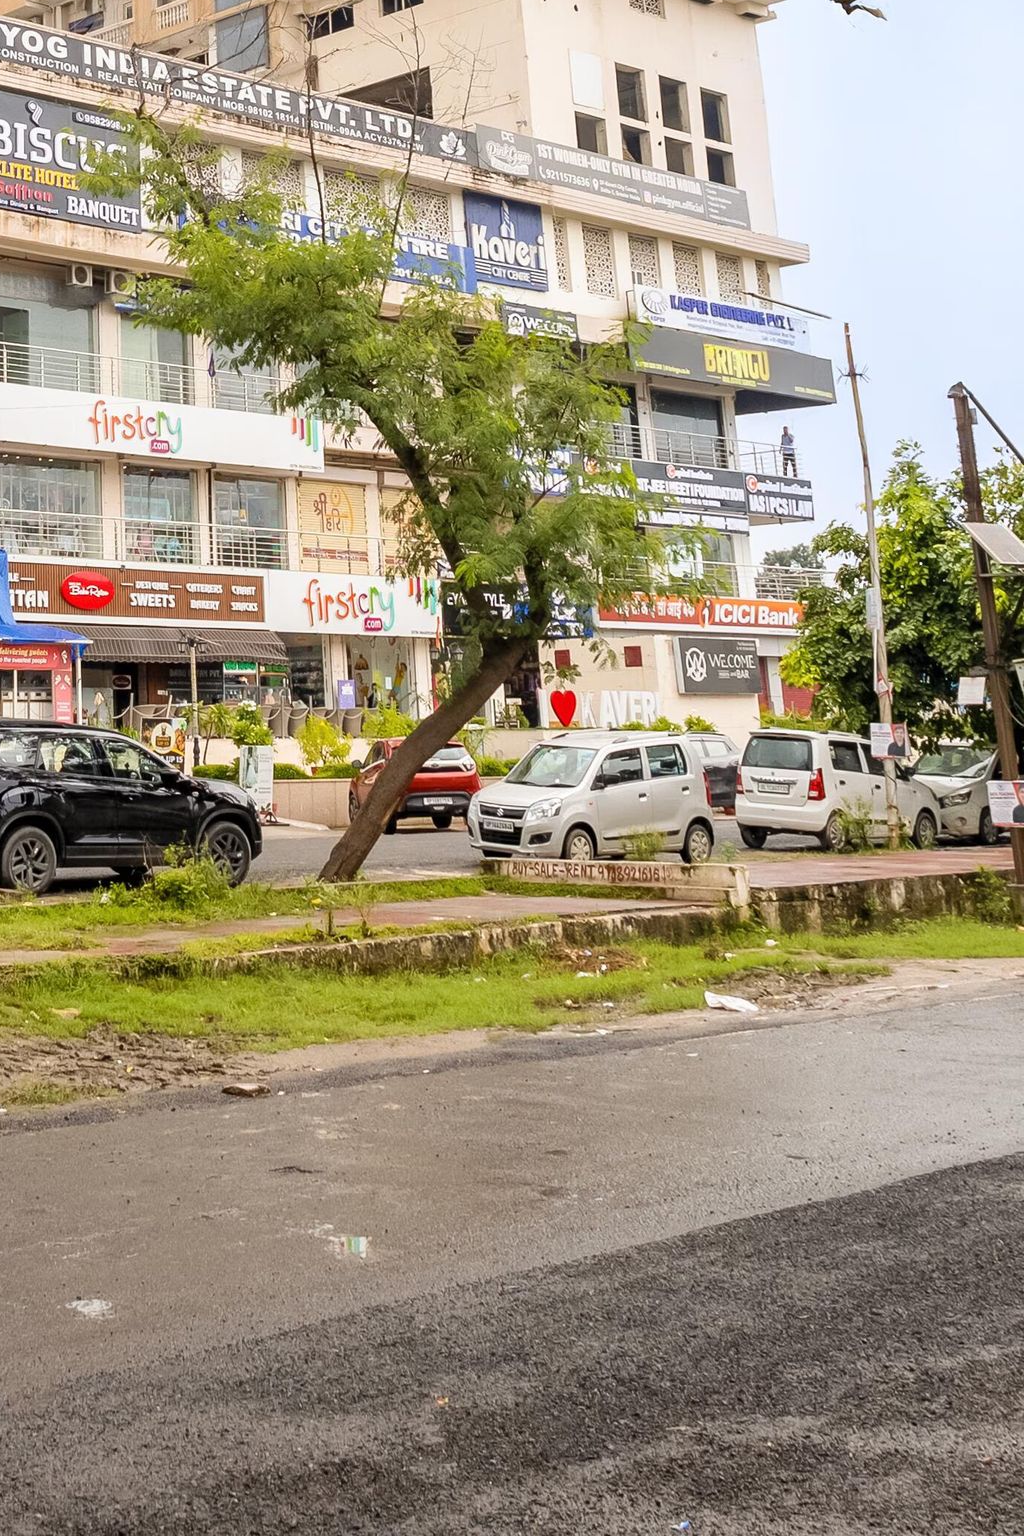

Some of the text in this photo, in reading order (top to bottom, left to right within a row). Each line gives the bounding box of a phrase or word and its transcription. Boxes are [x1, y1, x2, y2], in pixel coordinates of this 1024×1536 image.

[0, 24, 421, 142] YOG INDIA ESTATE PVT. LTD.
[85, 67, 92, 78] &
[97, 70, 125, 86] REAL
[169, 86, 216, 106] COMPANY
[34, 165, 80, 191] HOTEL
[536, 144, 553, 159] 1ST
[612, 162, 631, 179] GYM
[642, 169, 676, 188] GREATER
[676, 176, 703, 196] NOIDA
[545, 169, 590, 188] 9211573636
[66, 195, 140, 226] BANQUET
[471, 224, 545, 269] Kaveri
[88, 400, 182, 453] firstcry
[770, 497, 788, 516] PCS
[129, 593, 176, 608] SWEETS
[303, 579, 395, 631] firstcry
[714, 604, 799, 627] ICICI Bank
[736, 669, 750, 679] BAR
